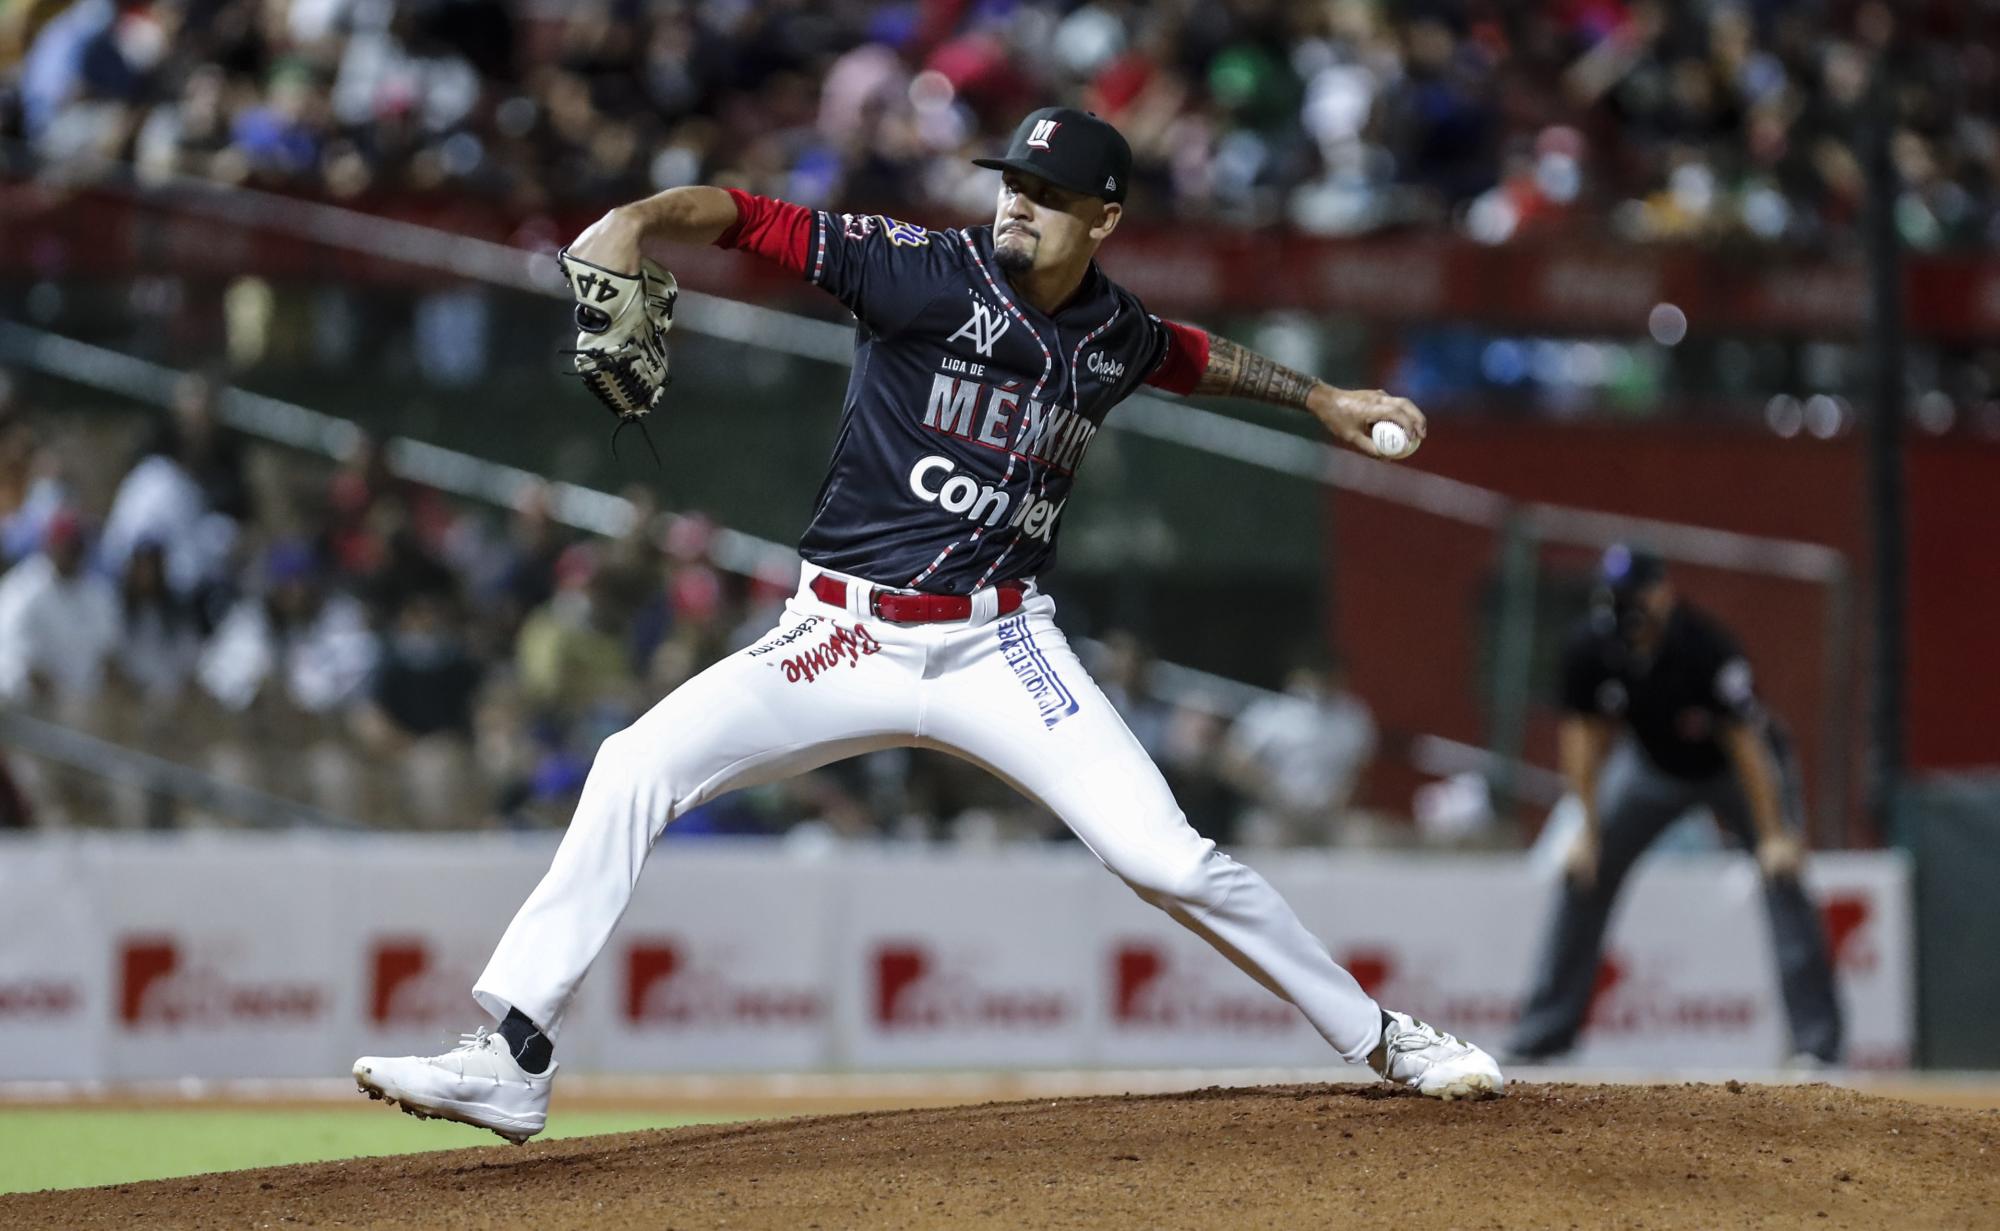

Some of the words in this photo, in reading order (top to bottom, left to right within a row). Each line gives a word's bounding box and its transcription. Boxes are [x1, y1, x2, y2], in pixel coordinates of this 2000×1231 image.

[577, 272, 619, 304] 44
[941, 357, 967, 373] LIGA
[969, 362, 986, 377] DE
